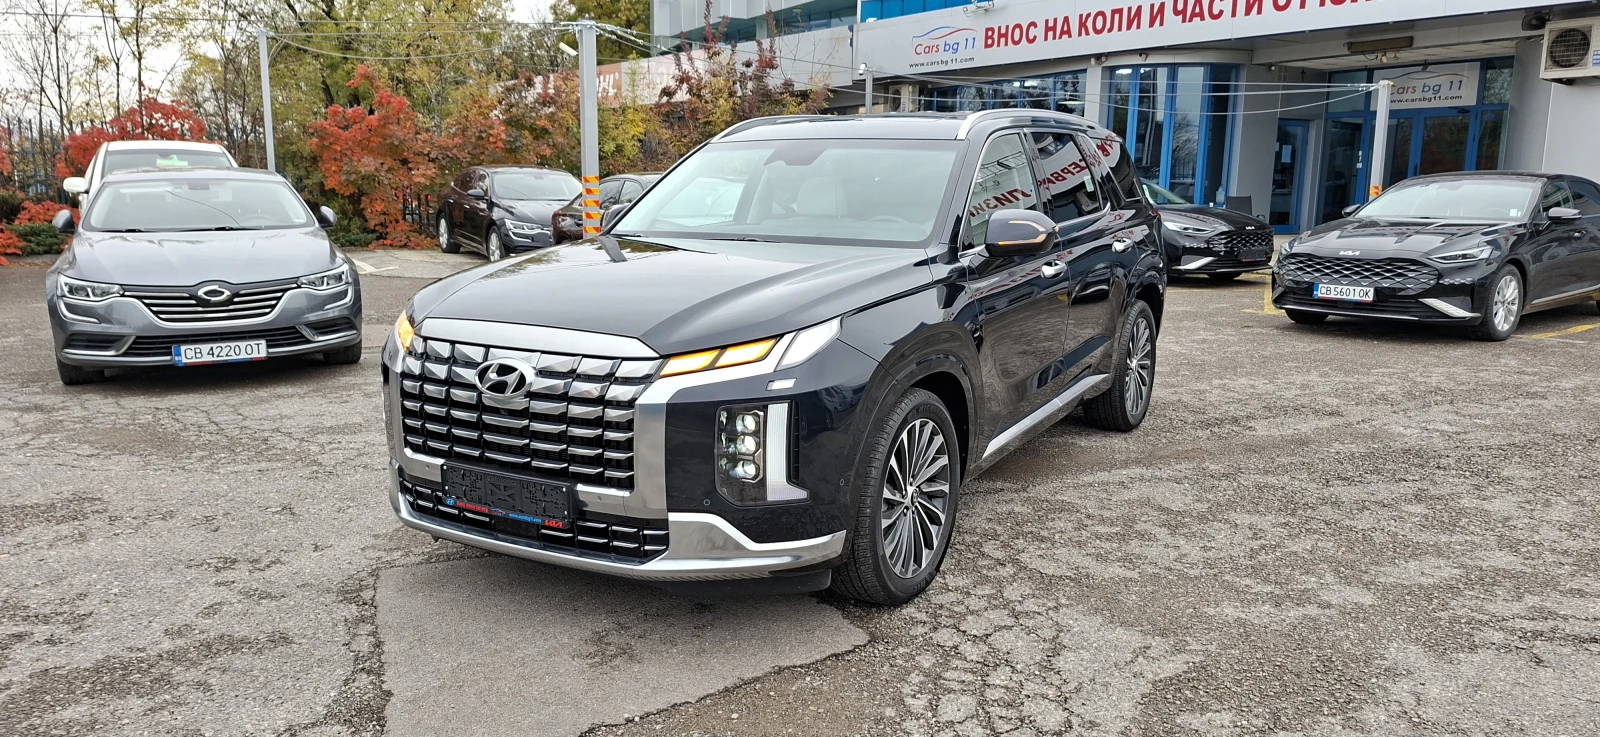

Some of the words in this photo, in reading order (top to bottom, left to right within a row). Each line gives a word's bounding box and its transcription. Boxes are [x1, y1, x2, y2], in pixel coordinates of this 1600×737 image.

[984, 21, 1038, 49] ВНОС
[1043, 16, 1073, 42] НА
[1077, 5, 1142, 37] КОЛИ
[1148, 2, 1166, 28] И
[914, 43, 940, 56] Cars
[943, 40, 960, 54] bg
[963, 37, 977, 50] 11
[1421, 82, 1442, 95] bg
[1448, 80, 1463, 91] 11
[1390, 95, 1463, 104] ww.carsbg11.com
[1333, 287, 1356, 297] 5601
[184, 347, 203, 360] CB
[207, 344, 242, 359] 4220
[244, 342, 263, 356] OT
